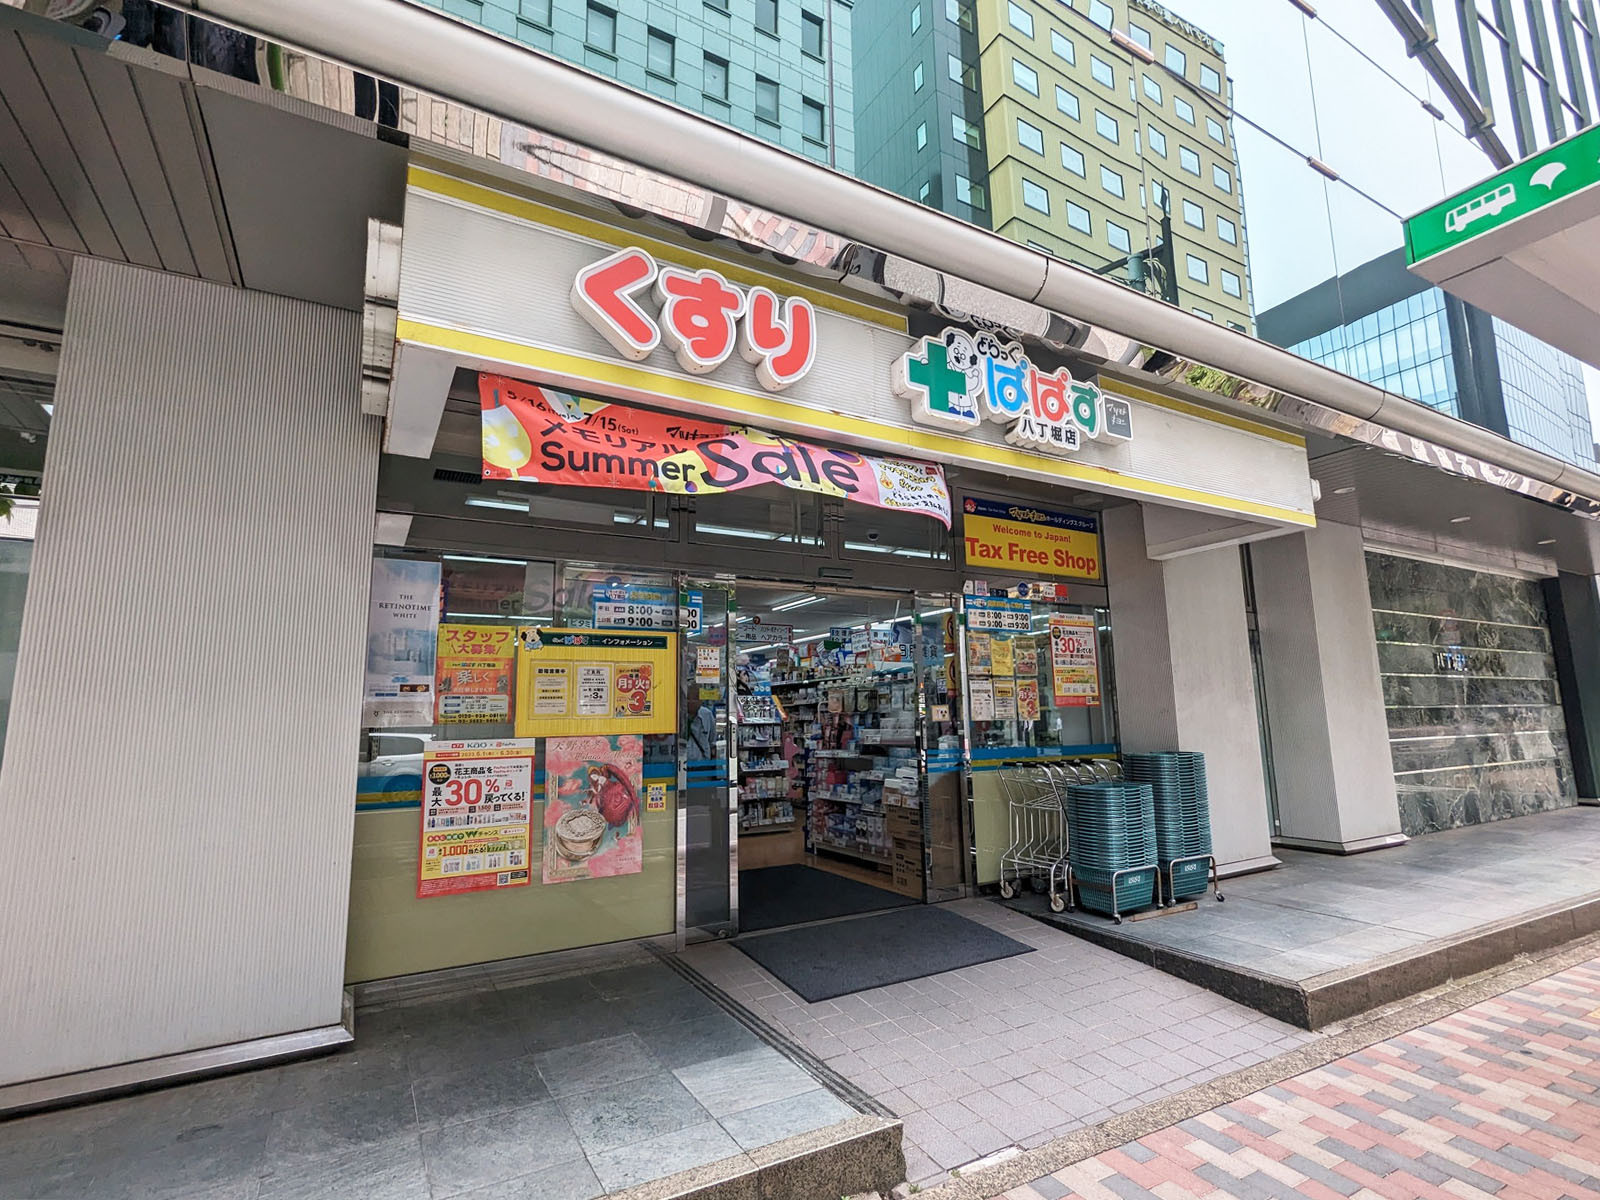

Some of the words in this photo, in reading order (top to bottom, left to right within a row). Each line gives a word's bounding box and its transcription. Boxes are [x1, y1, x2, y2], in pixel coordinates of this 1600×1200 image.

[576, 248, 815, 382] くすり
[975, 335, 1020, 363] どらっぐ
[985, 357, 1099, 433] ぱぱす
[541, 418, 688, 455] メモリアル
[1021, 418, 1077, 446] 八丁堀店
[541, 441, 696, 482] Summer
[697, 438, 860, 493] Sale
[992, 523, 1032, 538] Welcome
[1034, 530, 1043, 540] to
[1044, 532, 1071, 544] Japan!
[965, 536, 1003, 561] Tax
[1008, 543, 1049, 566] Free
[1053, 549, 1097, 576] Shop
[378, 602, 432, 612] RETINOTIME
[627, 605, 653, 616] 8:00
[627, 616, 653, 627] 9:00
[445, 629, 510, 643] スタッフ
[457, 644, 497, 655] 大募集
[601, 638, 654, 647] インフォメーション
[445, 778, 500, 807] 30%
